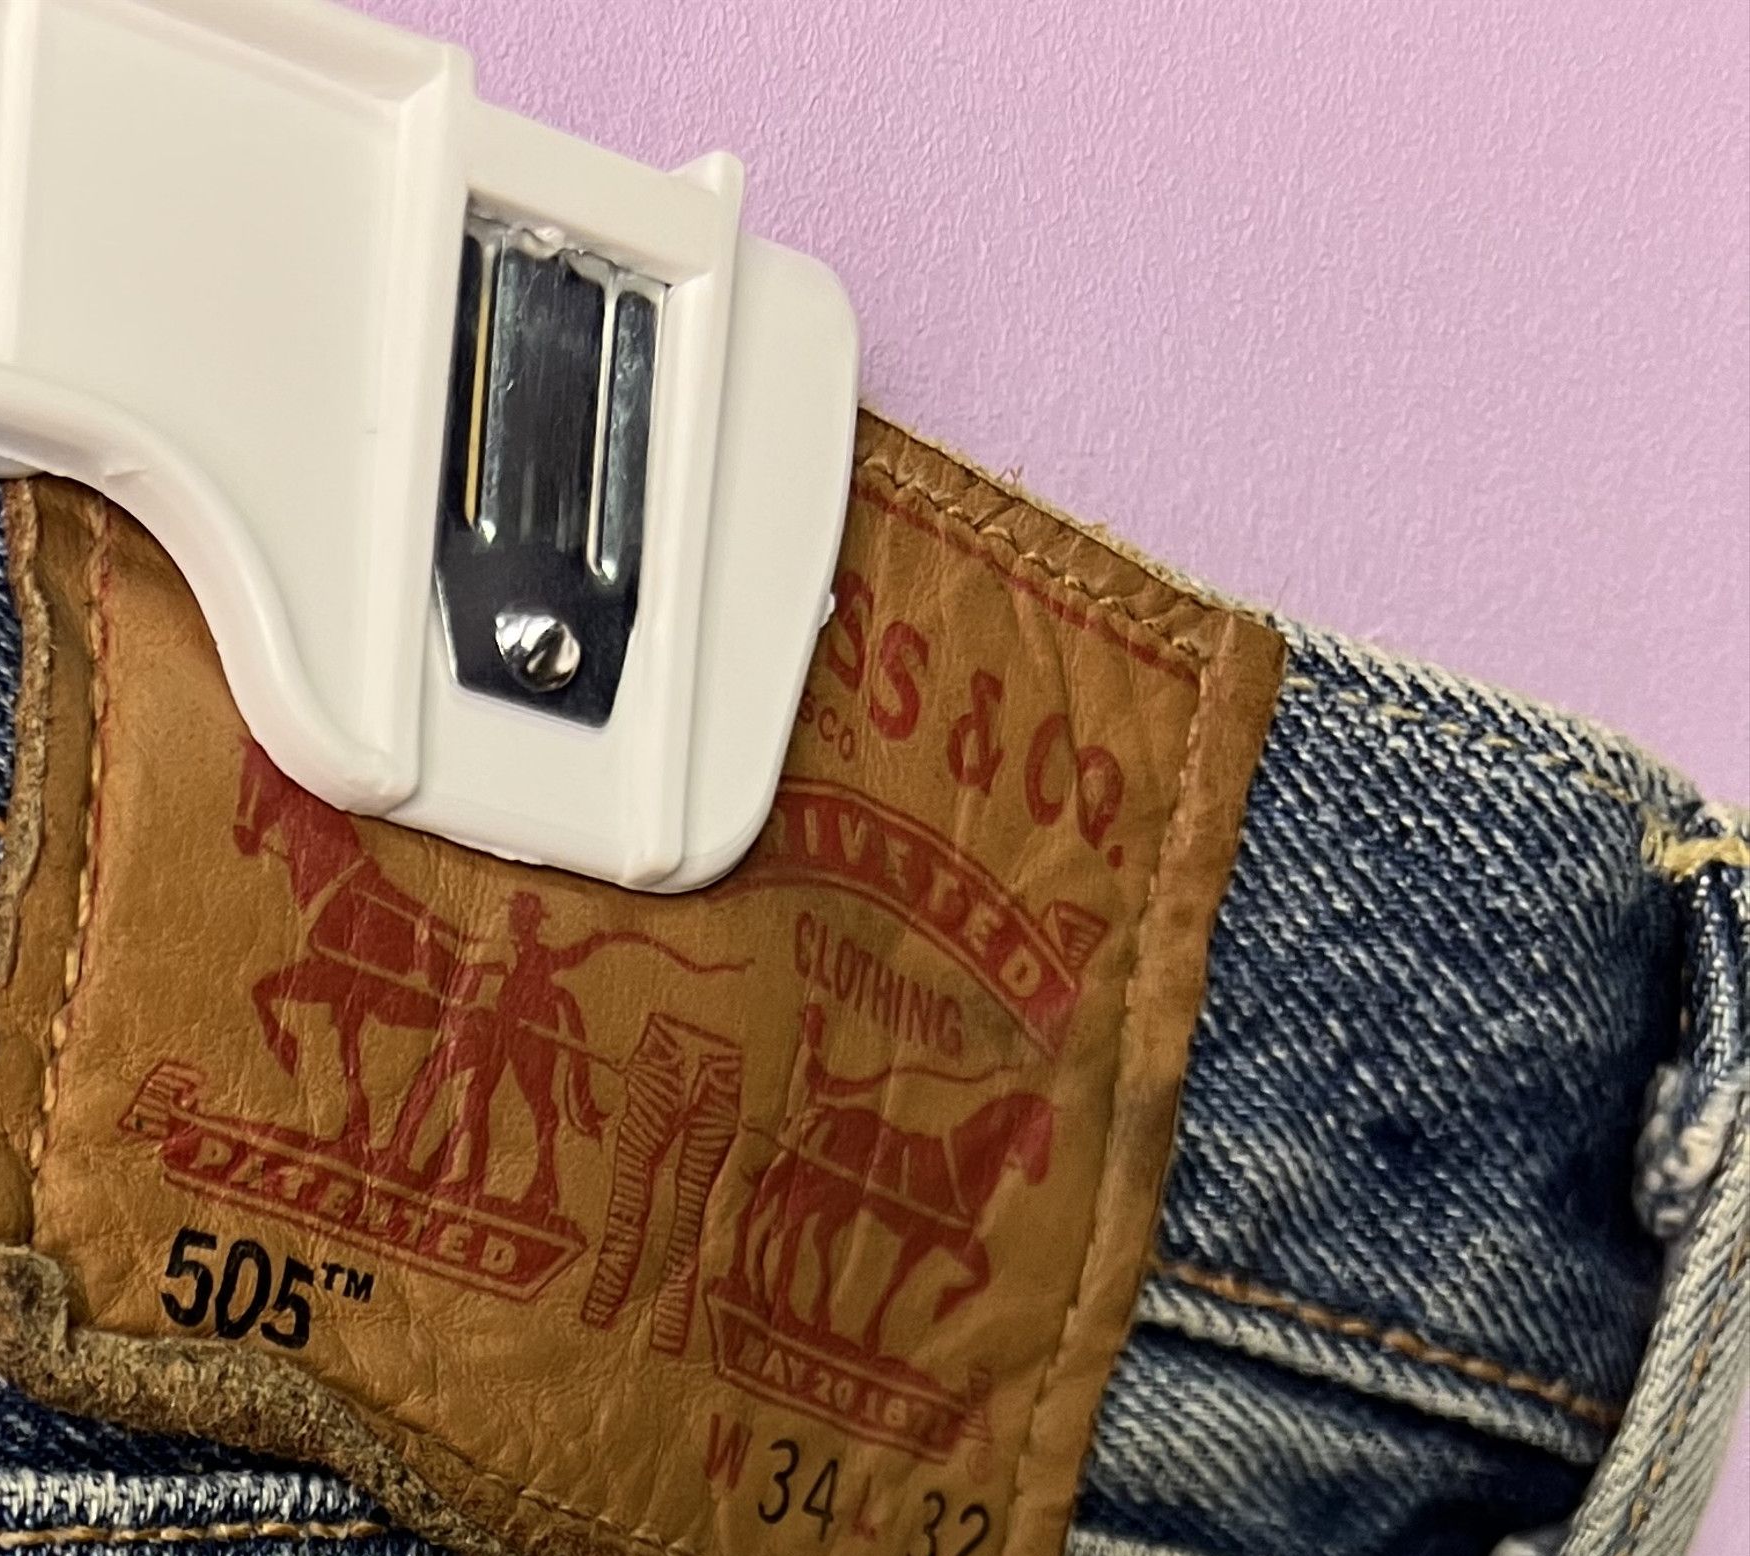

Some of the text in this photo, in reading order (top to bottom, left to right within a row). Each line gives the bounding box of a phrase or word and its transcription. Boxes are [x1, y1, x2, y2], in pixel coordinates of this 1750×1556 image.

[947, 667, 1003, 794] &
[795, 910, 964, 1059] CLOTHING
[186, 1133, 519, 1276] PATENTED
[704, 1412, 753, 1492] W
[757, 1438, 840, 1543] 34
